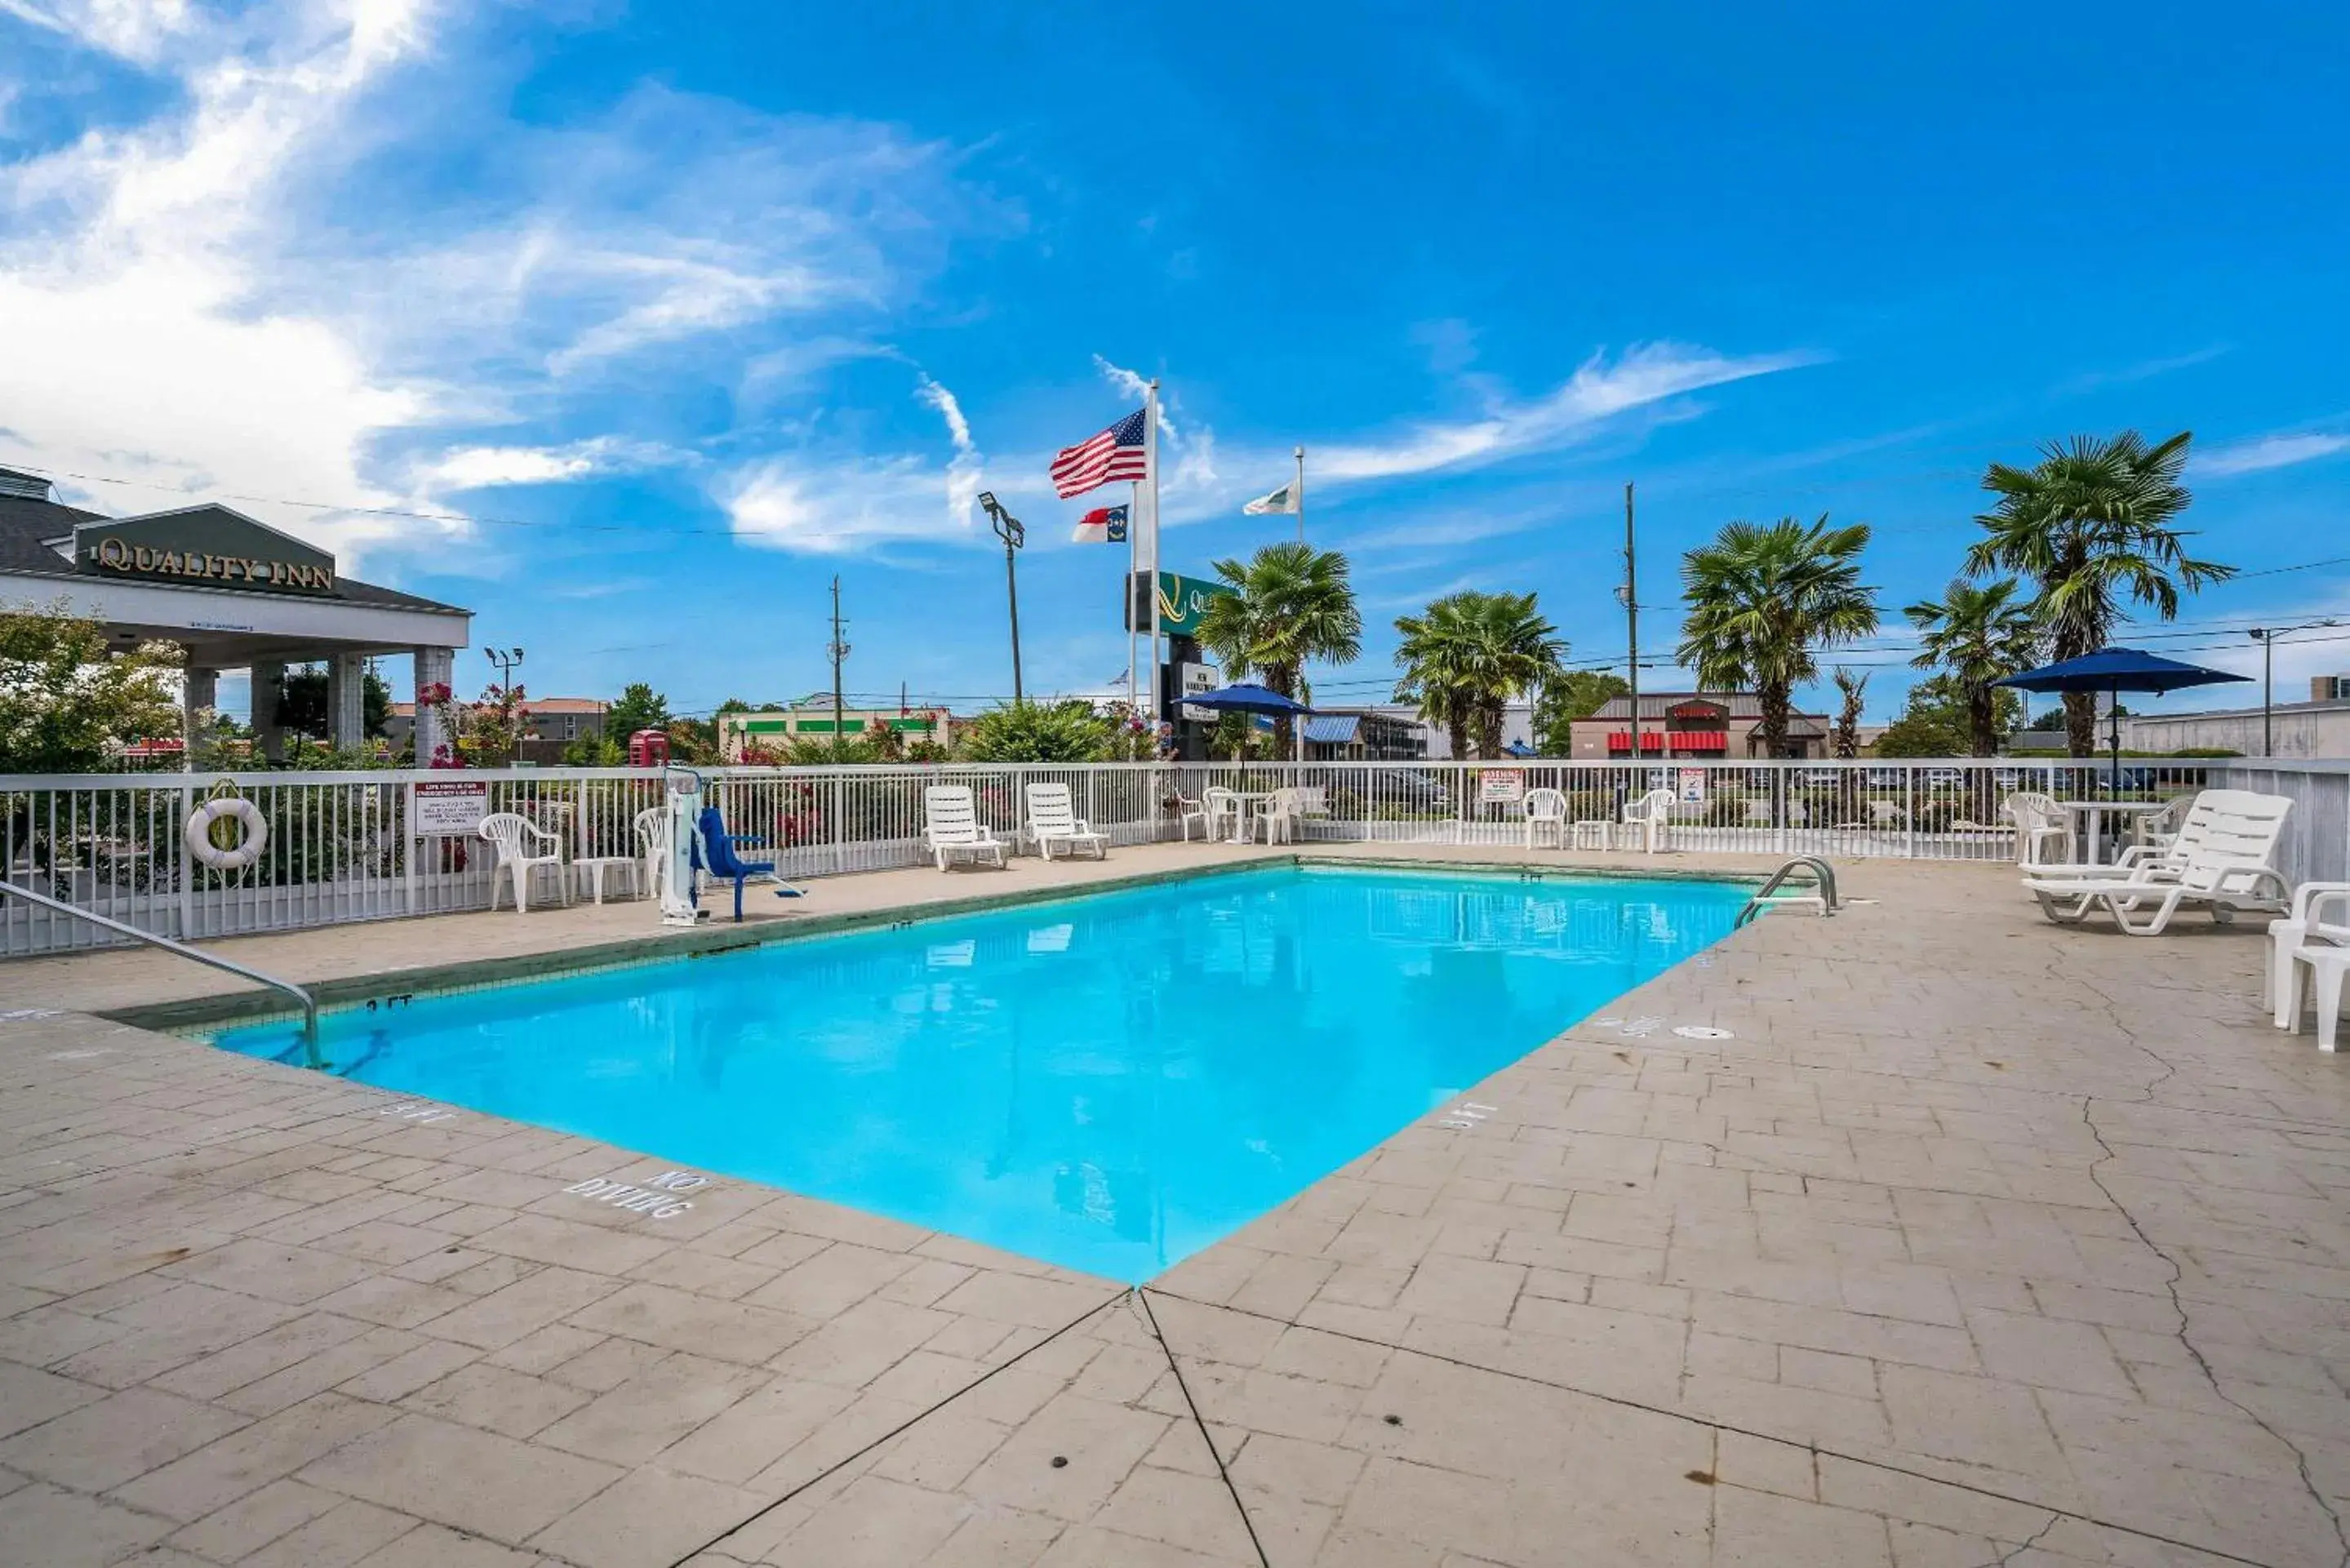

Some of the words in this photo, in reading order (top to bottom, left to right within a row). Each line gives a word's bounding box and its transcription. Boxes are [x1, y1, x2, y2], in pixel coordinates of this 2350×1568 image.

[99, 537, 258, 582] QUALITY
[269, 561, 333, 590] INN
[563, 1179, 692, 1218] DIVING
[642, 1170, 709, 1190] NO
